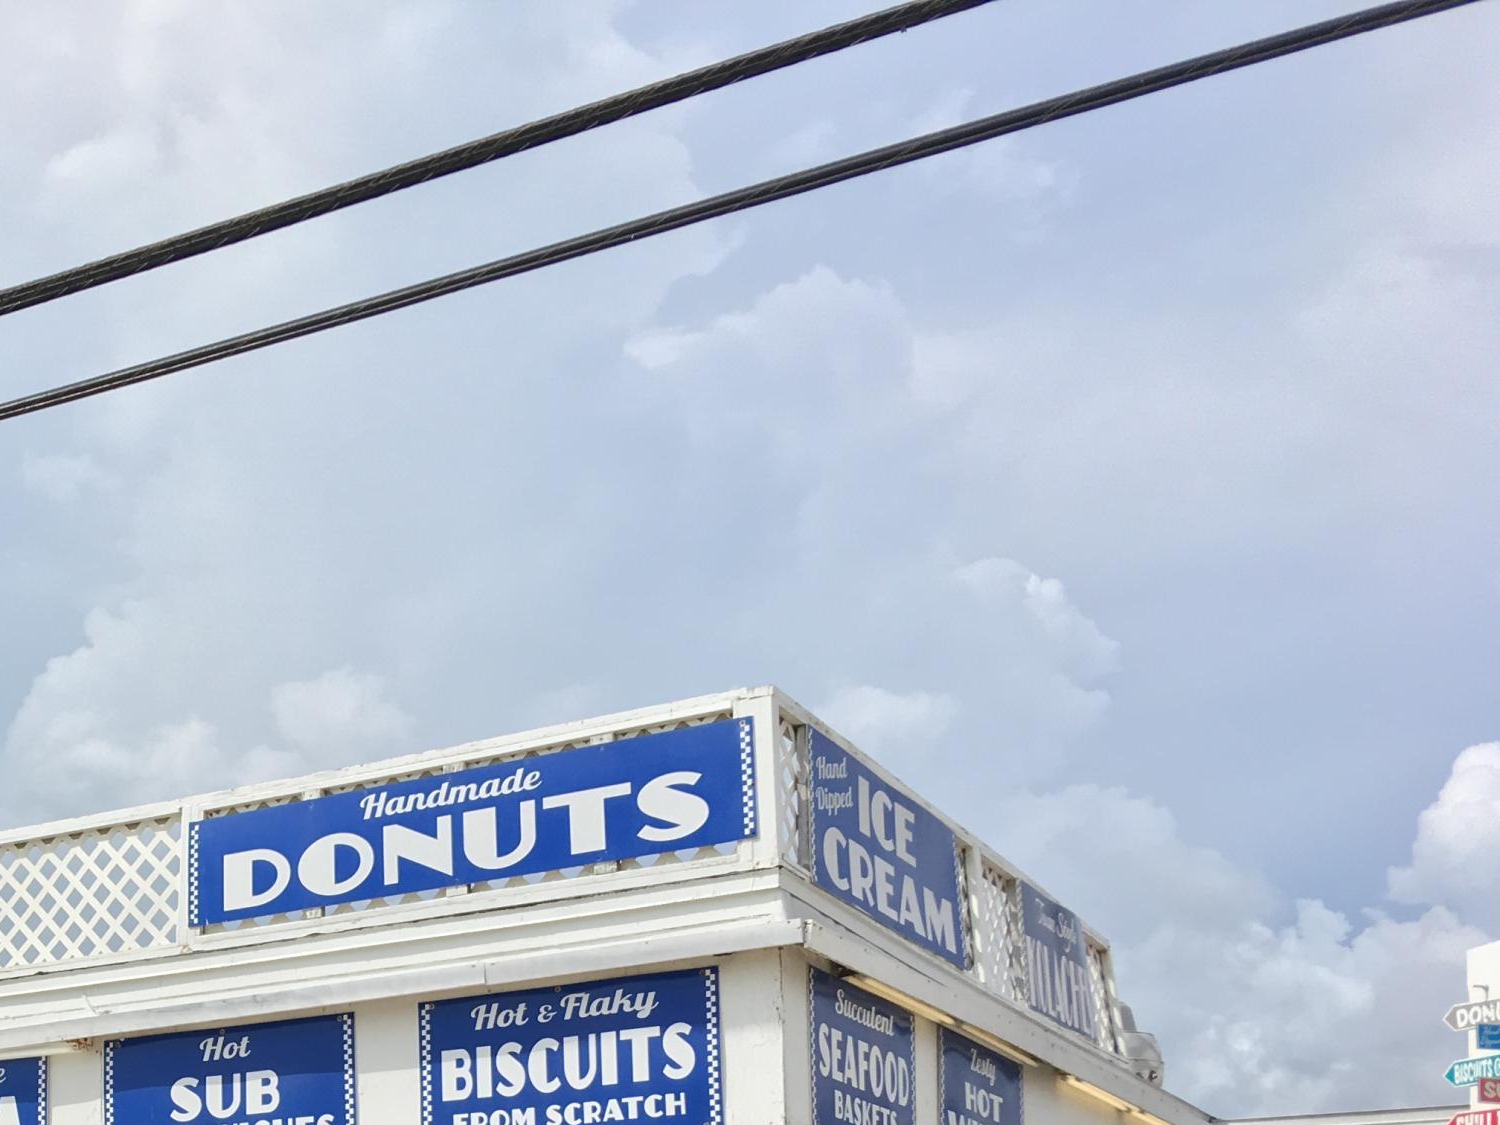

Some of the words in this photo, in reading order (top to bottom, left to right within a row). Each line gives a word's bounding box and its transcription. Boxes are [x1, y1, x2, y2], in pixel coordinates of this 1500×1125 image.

[815, 756, 847, 780] Hand
[359, 767, 542, 820] Handmade
[815, 786, 853, 816] Dipped
[223, 770, 710, 912] DONUTS
[857, 775, 917, 868] ICE
[823, 826, 956, 954] CREAM
[470, 1003, 530, 1030] Hot
[539, 1004, 557, 1024] &
[560, 988, 658, 1021] Flaky
[835, 989, 894, 1037] Succulent
[199, 1034, 251, 1062] Hot
[441, 1021, 696, 1102] BISCUITS
[819, 1023, 909, 1107] SEAFOOD
[971, 1049, 996, 1086] Zesty
[1454, 1058, 1493, 1085] BISCUITS
[169, 1069, 280, 1123] SUB
[965, 1082, 1003, 1123] HOT
